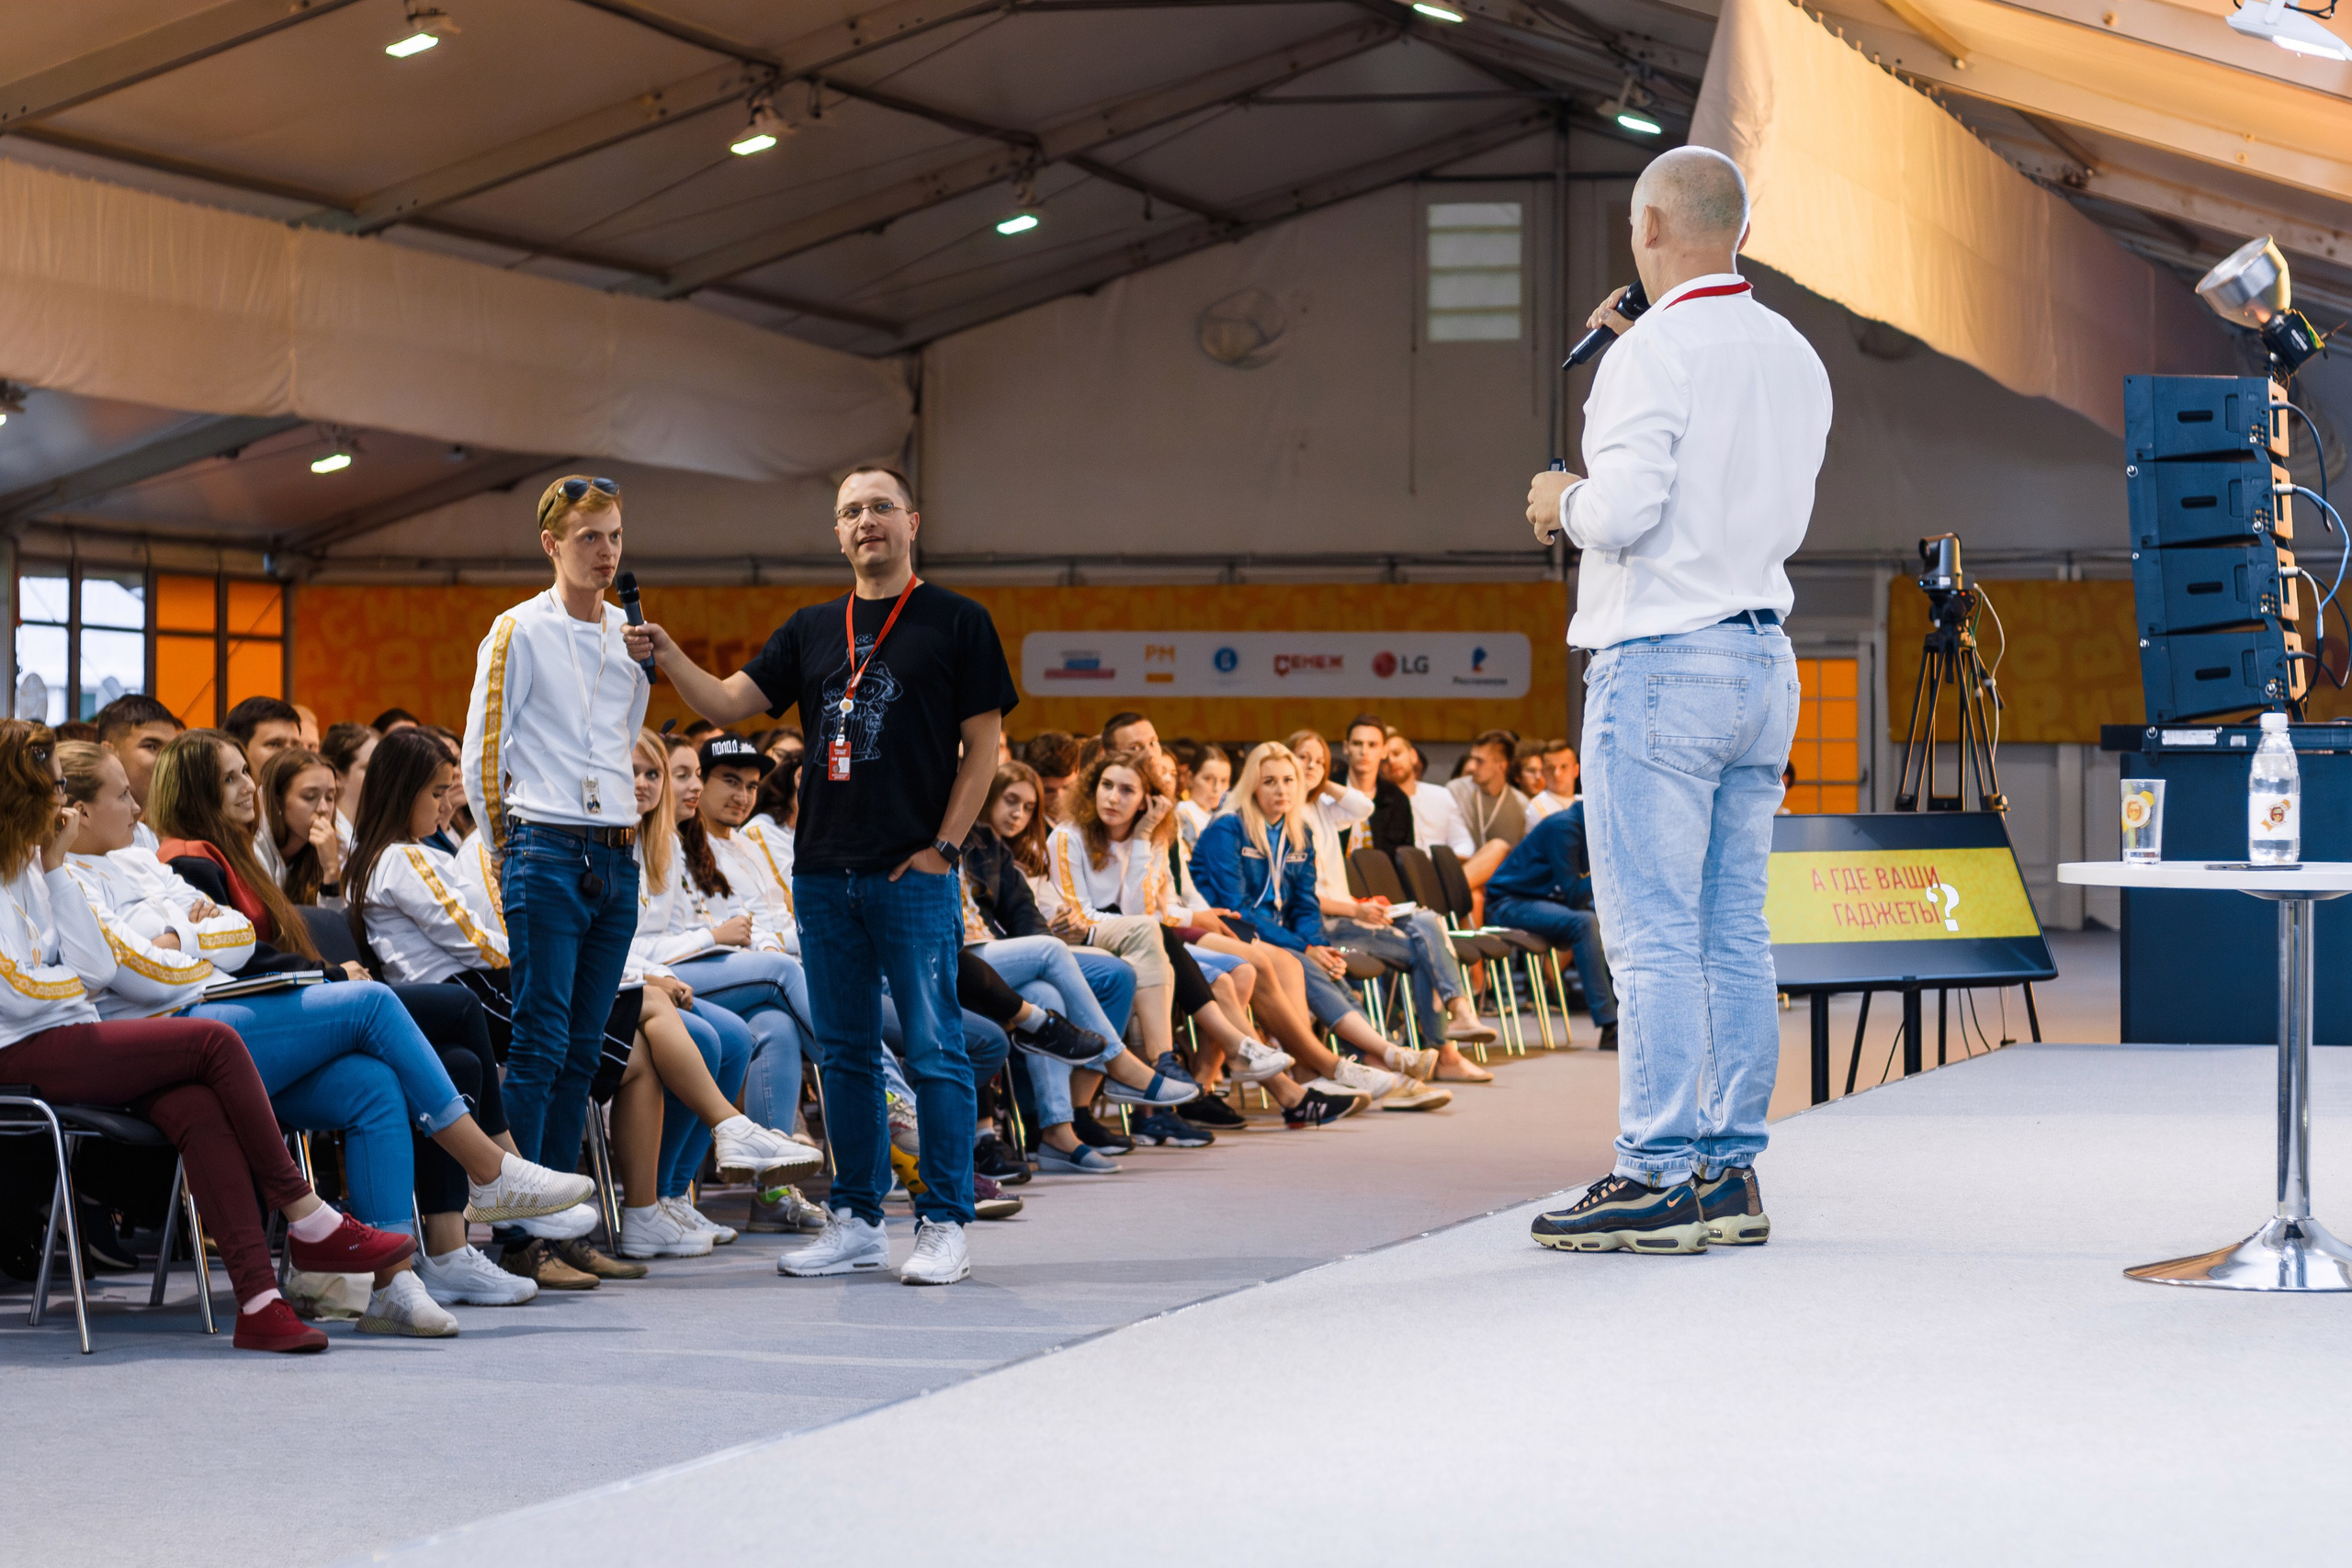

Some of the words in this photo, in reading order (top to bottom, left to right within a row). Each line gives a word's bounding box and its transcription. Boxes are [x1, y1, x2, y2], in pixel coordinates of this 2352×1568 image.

[1401, 655, 1430, 674] LG
[1811, 868, 1826, 892] А
[1829, 866, 1871, 895] ГДЕ
[1874, 865, 1941, 890] ВАШИ
